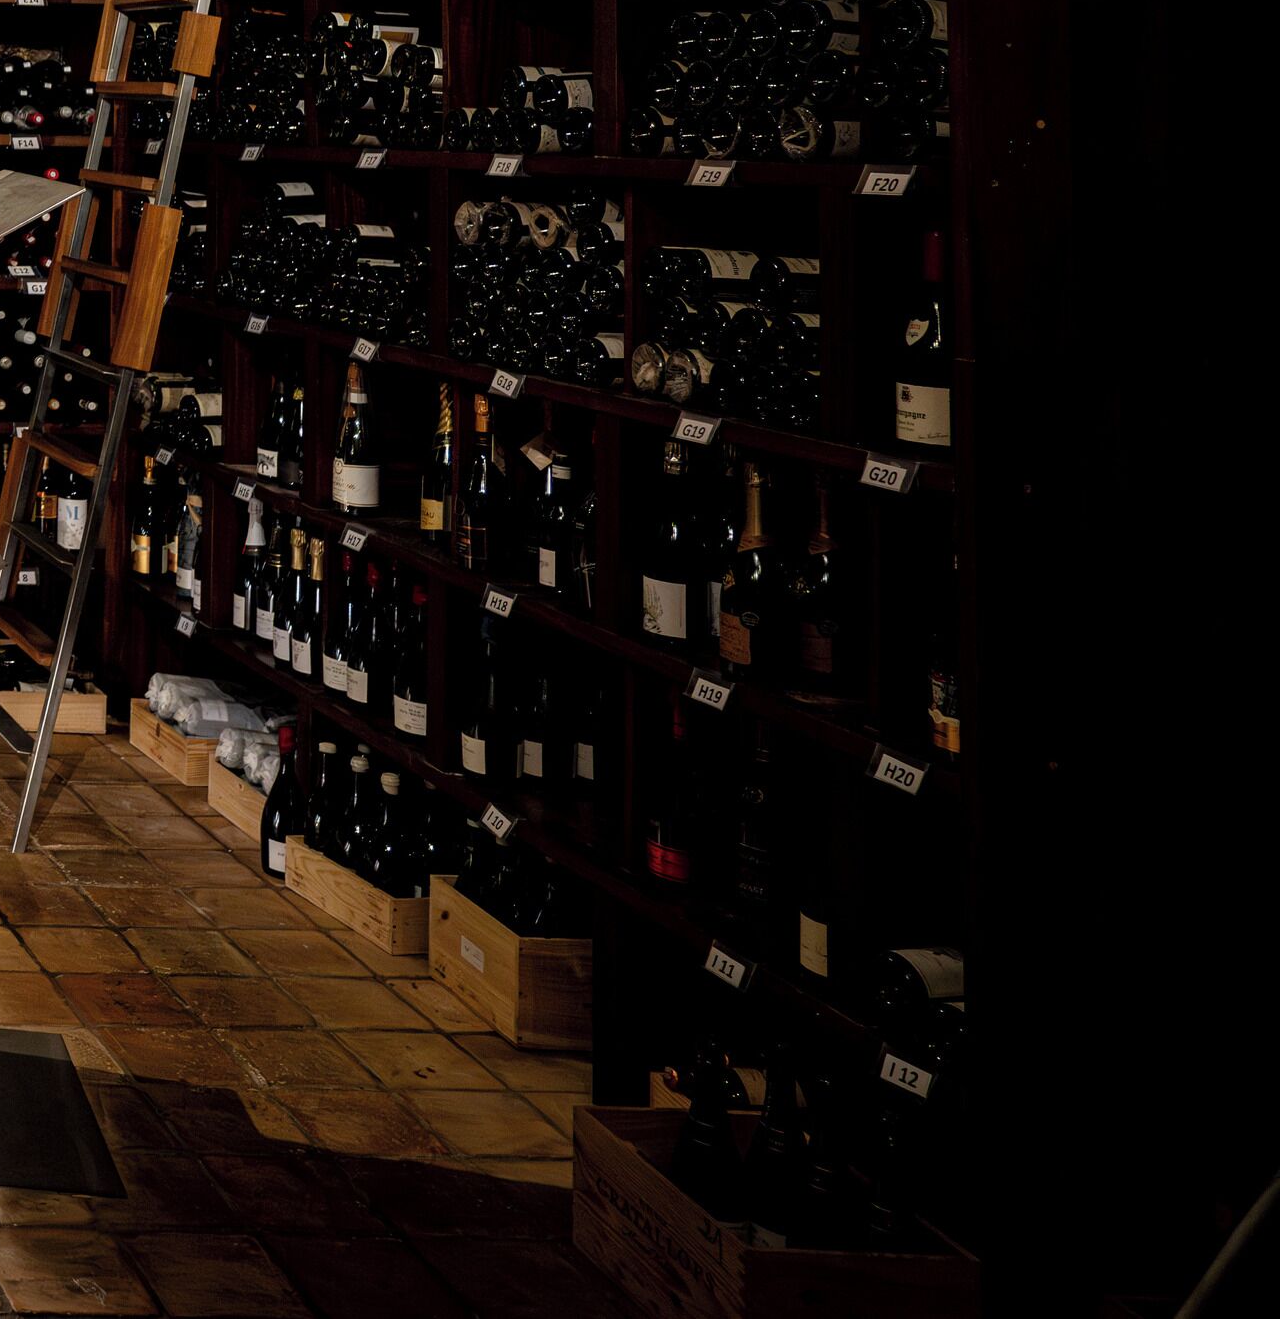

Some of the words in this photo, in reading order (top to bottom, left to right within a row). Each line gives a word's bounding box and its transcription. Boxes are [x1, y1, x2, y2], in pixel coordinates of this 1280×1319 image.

[365, 156, 378, 165] F17
[495, 162, 511, 173] F18
[699, 170, 721, 183] F19
[871, 178, 899, 192] F20
[32, 285, 47, 293] G1
[250, 321, 260, 331] G16
[358, 343, 371, 355] G17
[497, 375, 513, 391] G18
[682, 424, 706, 439] G19
[869, 467, 898, 485] G20
[238, 488, 250, 499] H16
[347, 535, 361, 547] H17
[23, 574, 28, 582] 8
[490, 596, 508, 612] H18
[698, 684, 723, 704] H19
[884, 762, 915, 787] H20
